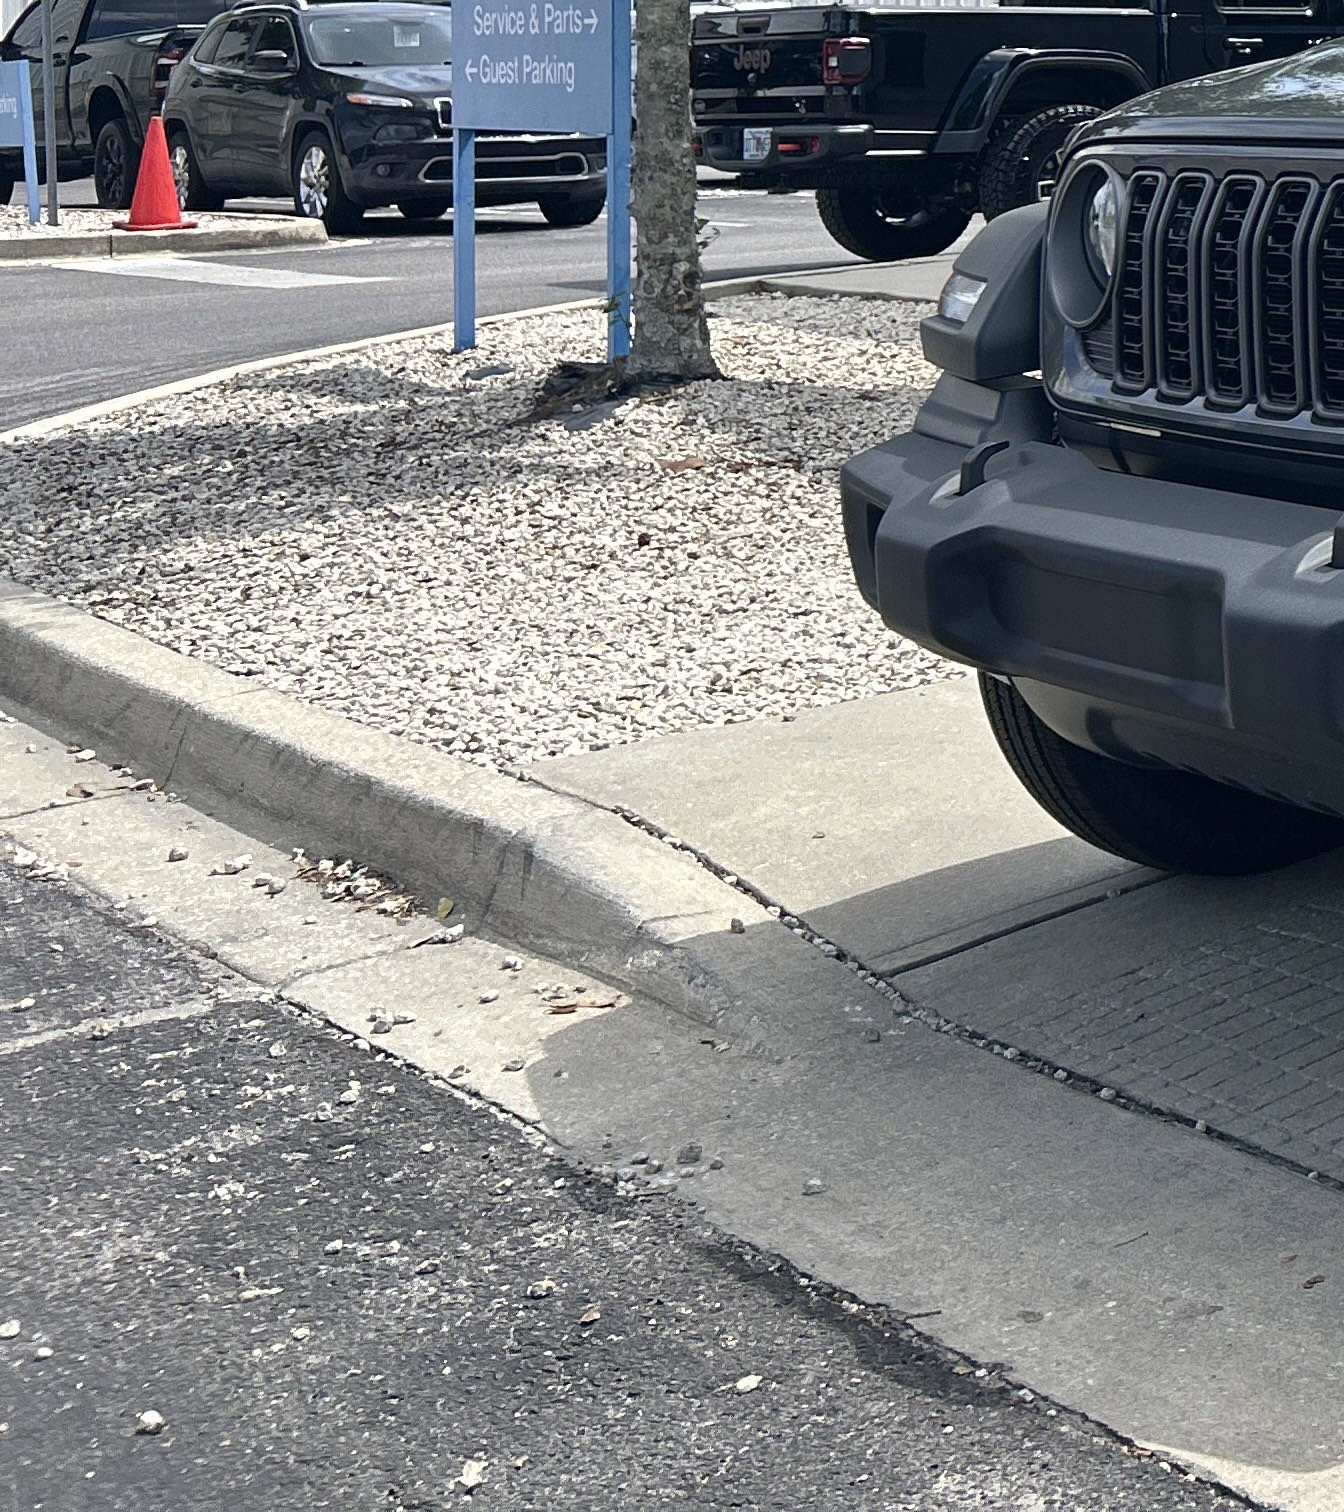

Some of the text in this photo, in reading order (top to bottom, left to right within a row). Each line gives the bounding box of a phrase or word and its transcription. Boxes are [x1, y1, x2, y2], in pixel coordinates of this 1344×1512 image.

[473, 3, 583, 36] Service & Parts
[479, 54, 575, 93] Guest Parking
[733, 44, 772, 75] Jeep
